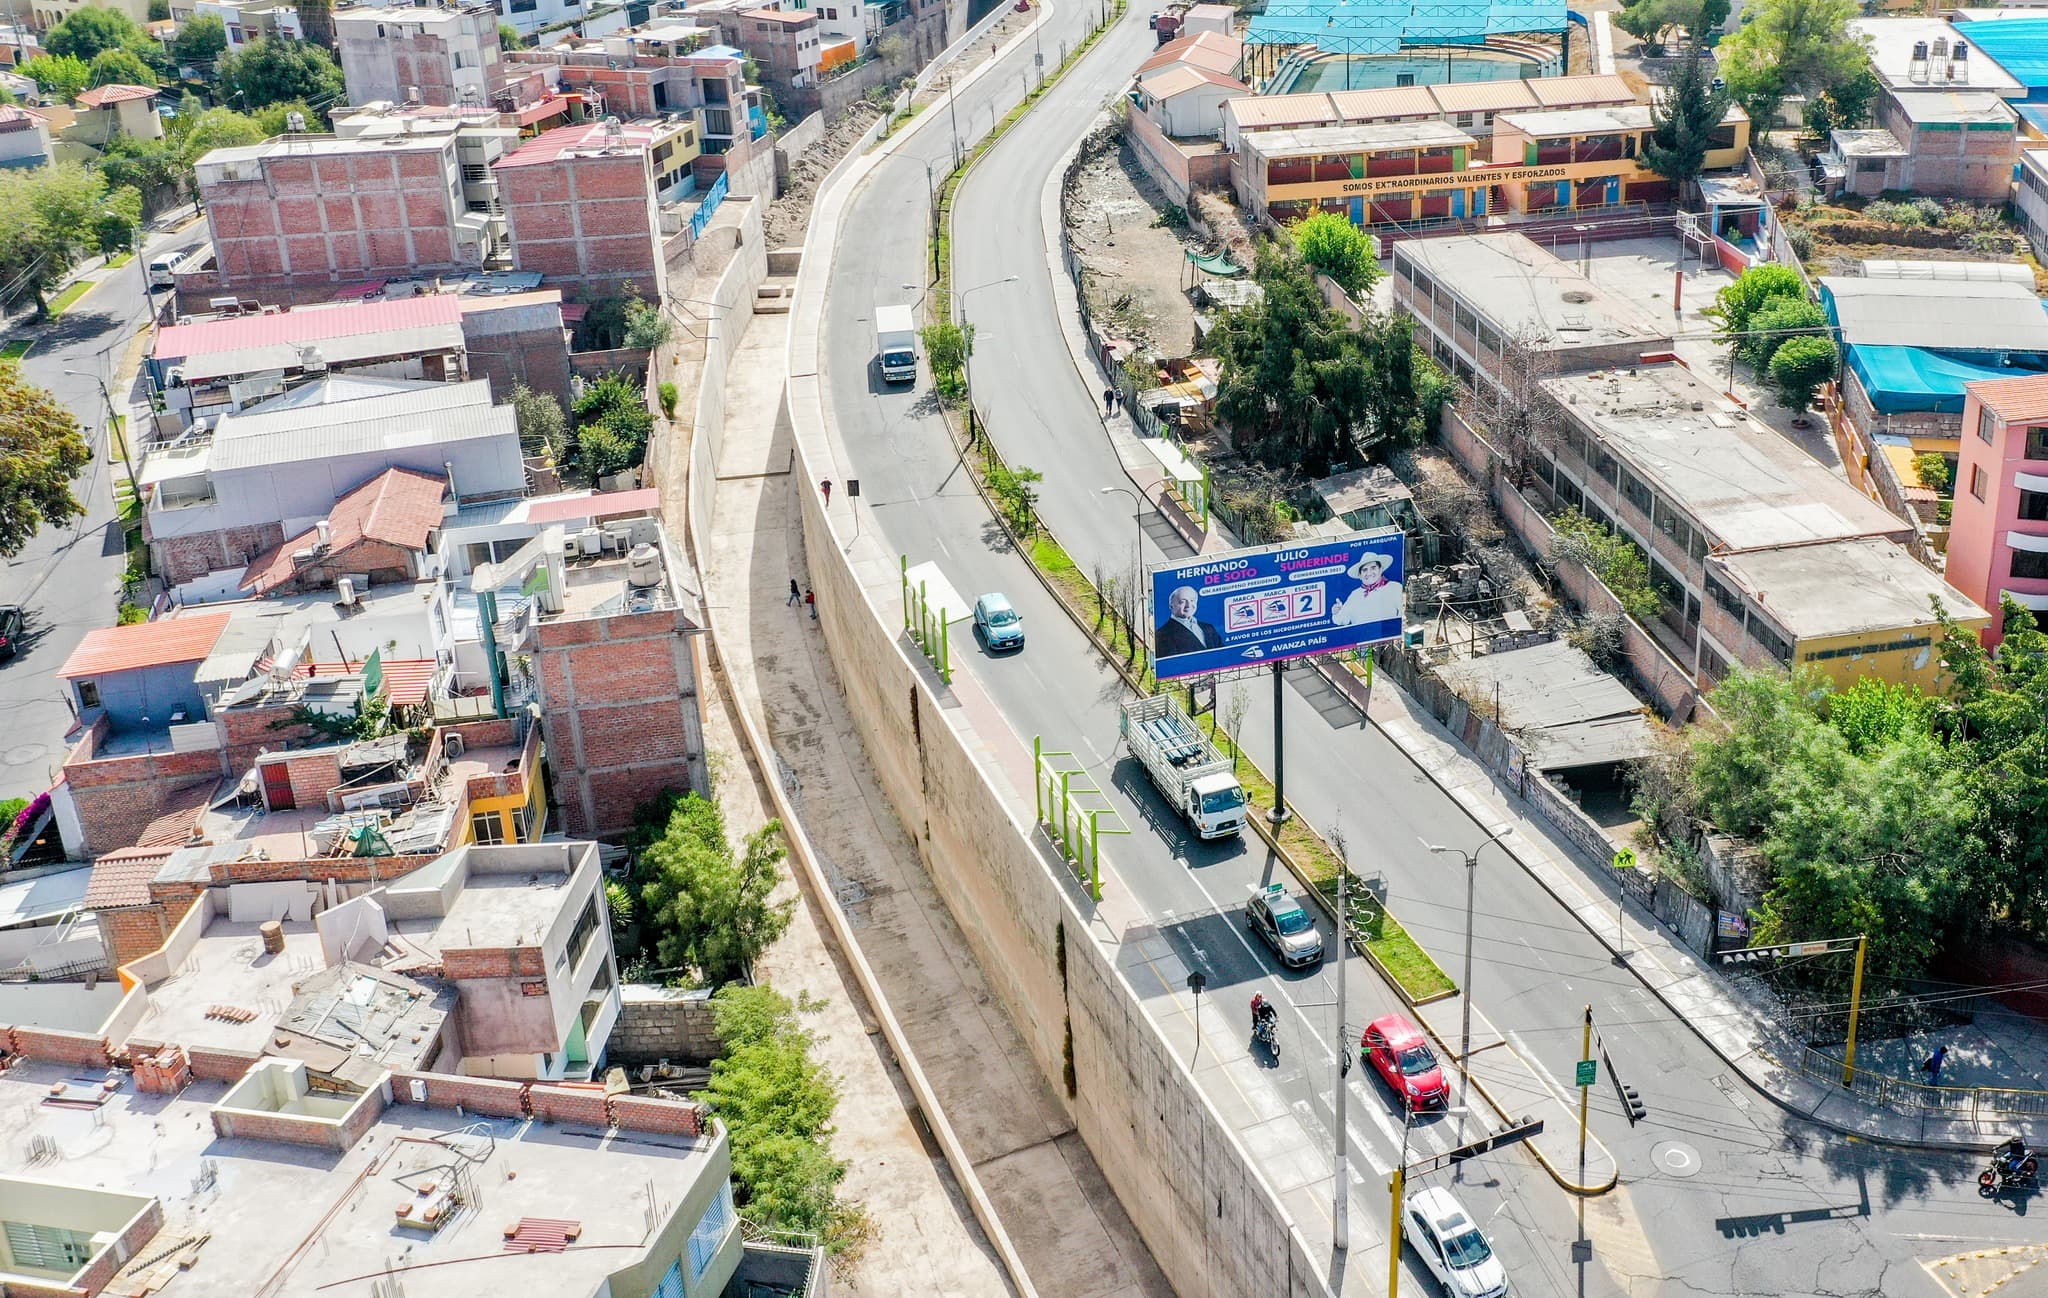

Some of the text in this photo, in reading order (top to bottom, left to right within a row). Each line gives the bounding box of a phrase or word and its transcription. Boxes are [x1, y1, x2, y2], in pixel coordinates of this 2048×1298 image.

[1343, 182, 1373, 192] SOMOS
[1375, 176, 1454, 189] EXTRAORDINARIOS
[1457, 172, 1502, 183] VALIENTES
[1512, 168, 1566, 179] ESFORZADOS
[1369, 536, 1398, 544] AREQUIPA
[1274, 549, 1309, 563] JULIO
[1280, 553, 1349, 571] SUMERINDE
[1177, 560, 1248, 579] HERNANDO
[1204, 568, 1257, 585] DE SOTO
[1247, 577, 1278, 586] PRESIDENTE
[1295, 584, 1318, 592] ESCRIBE
[1233, 594, 1255, 602] MARCA
[1300, 595, 1313, 612] 2
[1273, 619, 1331, 634] MICROEMPRESARIOS
[1271, 636, 1328, 652] AVANZA PAÍS
